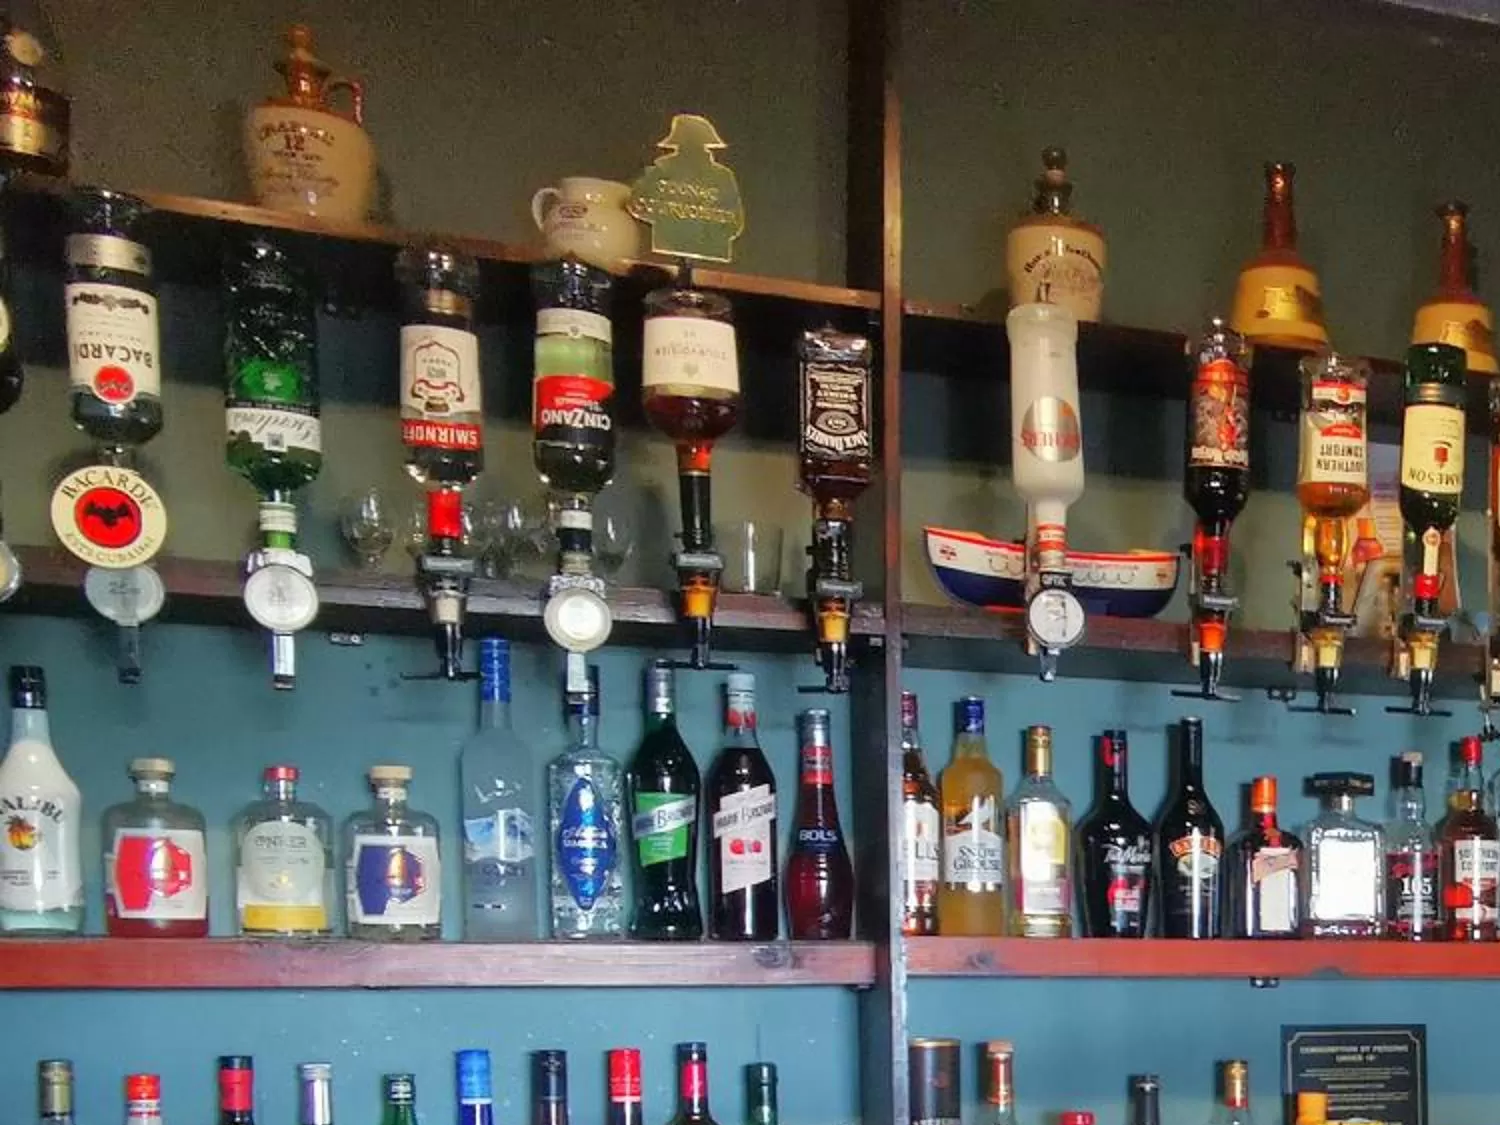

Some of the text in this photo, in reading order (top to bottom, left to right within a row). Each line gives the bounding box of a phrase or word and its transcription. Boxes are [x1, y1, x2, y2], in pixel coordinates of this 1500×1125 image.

[74, 343, 154, 368] BACARDI
[540, 407, 612, 432] CINZANO
[61, 470, 153, 504] BACARDI
[800, 829, 837, 843] BOLS
